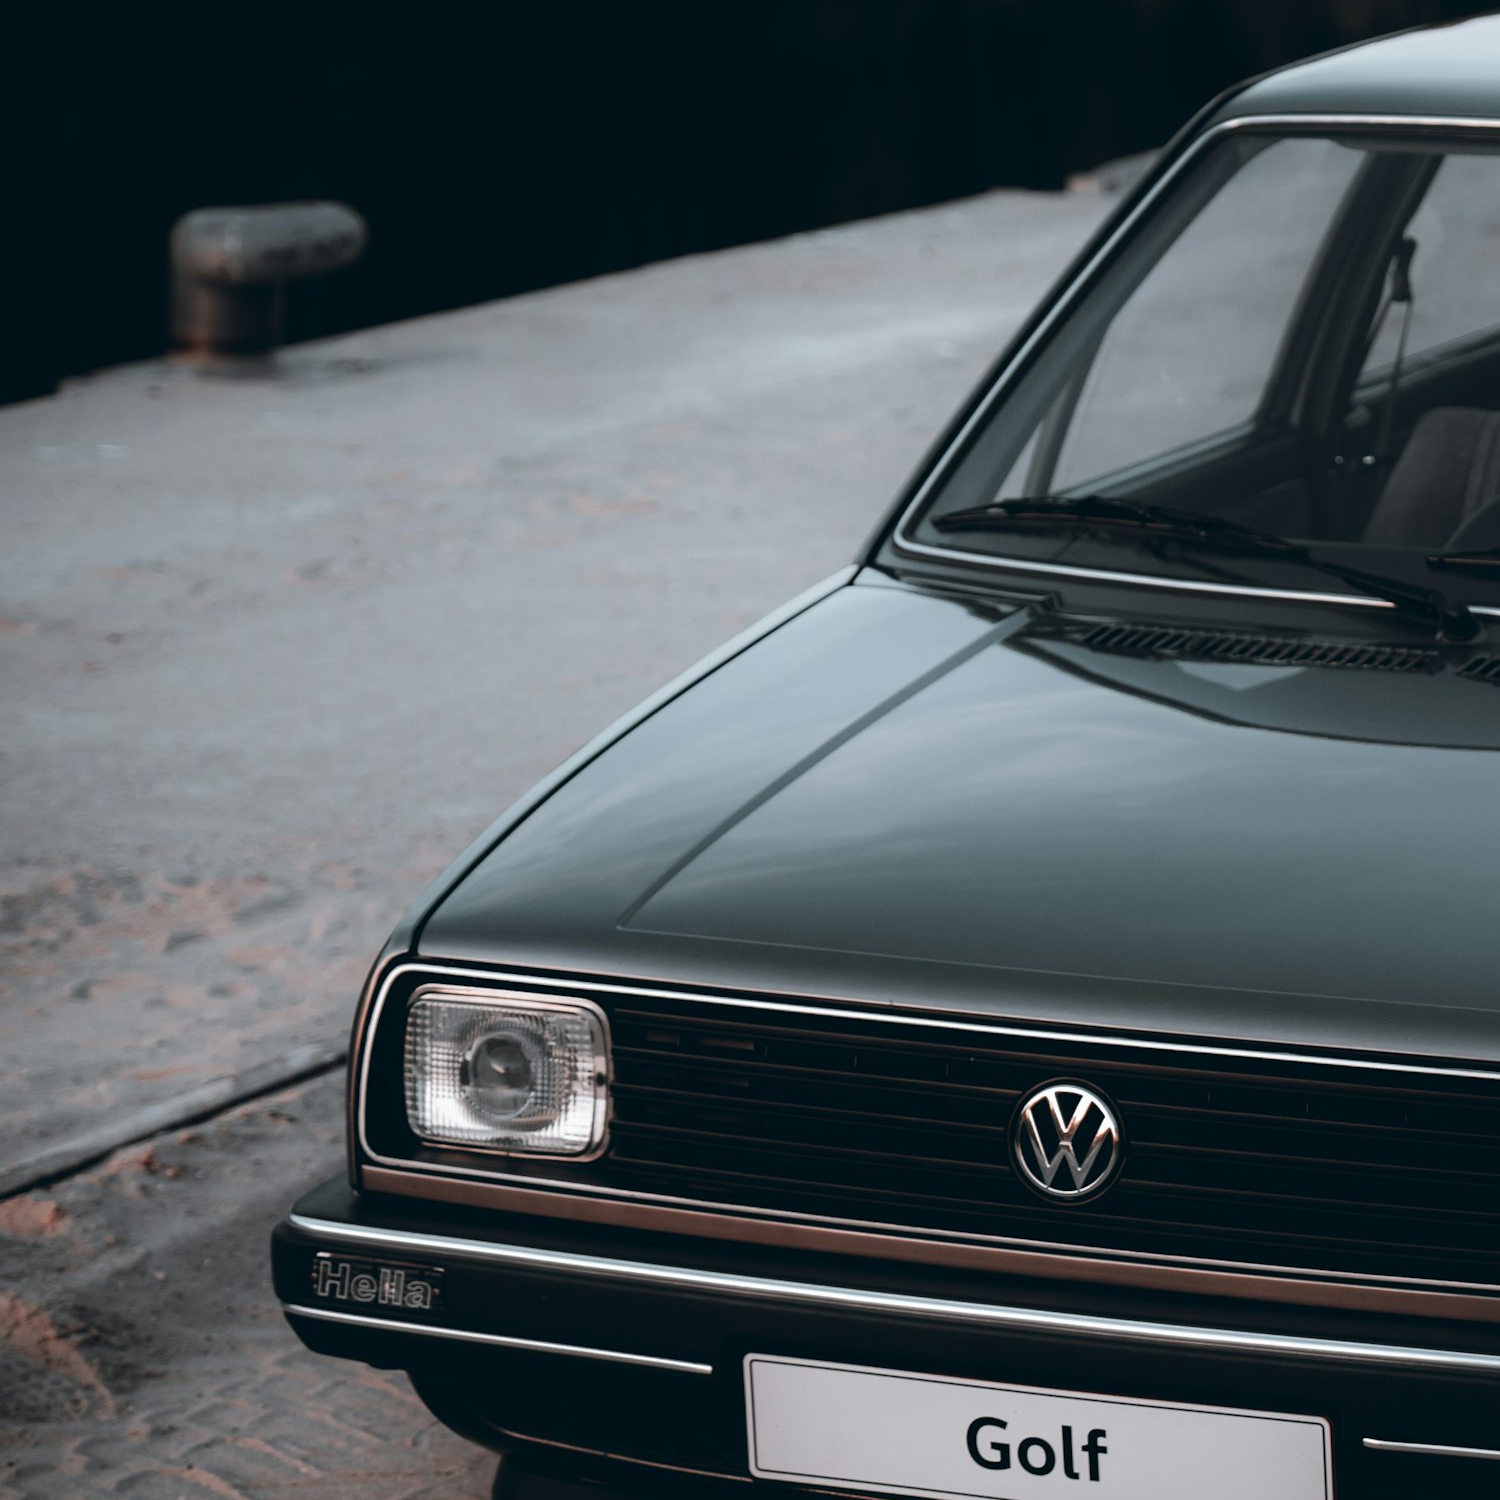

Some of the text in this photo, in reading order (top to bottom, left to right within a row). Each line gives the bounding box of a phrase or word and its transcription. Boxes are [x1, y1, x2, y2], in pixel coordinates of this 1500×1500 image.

[1015, 1085, 1119, 1196] VW
[318, 1260, 432, 1309] Hella
[966, 1416, 1108, 1482] Golf
